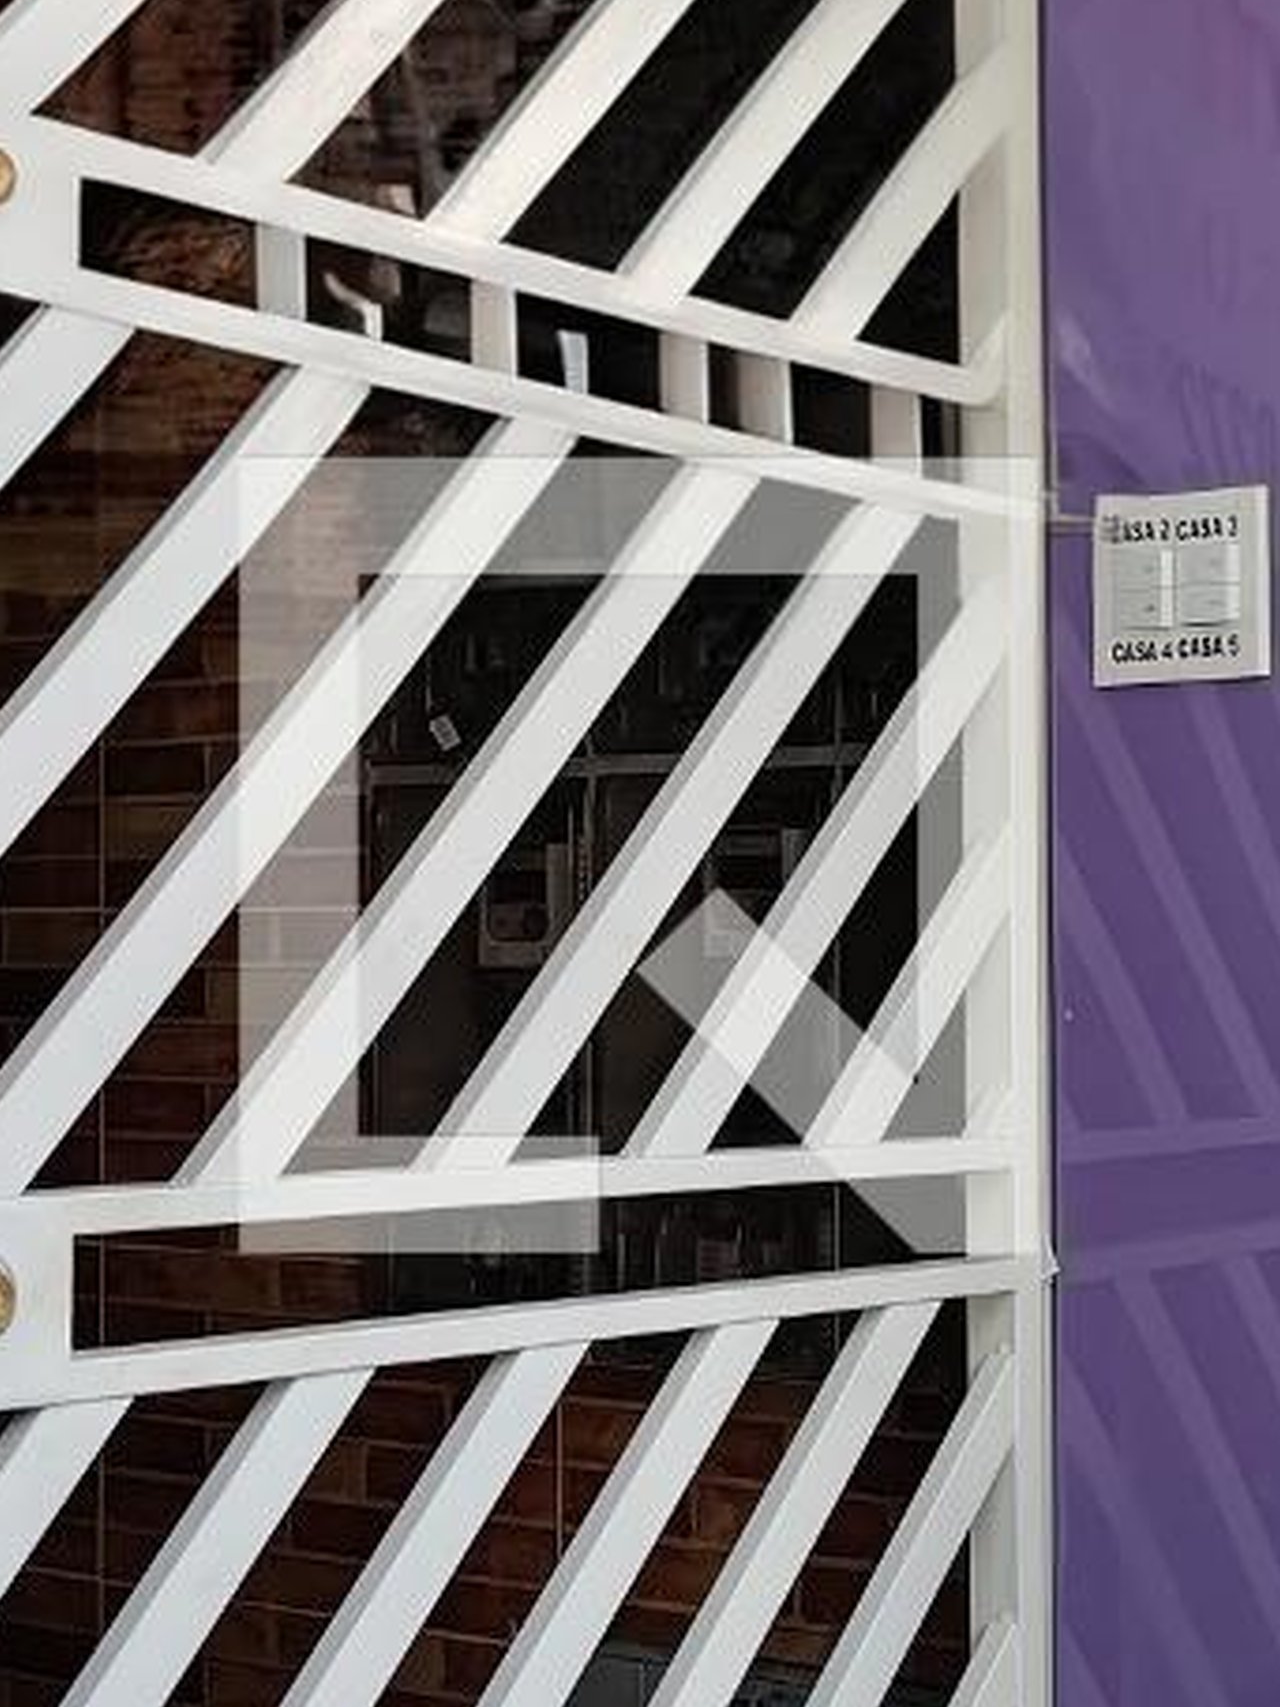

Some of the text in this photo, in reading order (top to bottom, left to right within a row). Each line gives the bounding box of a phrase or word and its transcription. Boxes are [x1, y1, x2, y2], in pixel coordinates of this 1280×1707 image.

[1176, 517, 1222, 541] CASA
[1112, 640, 1158, 664] CASA
[1178, 637, 1226, 658] CASA
